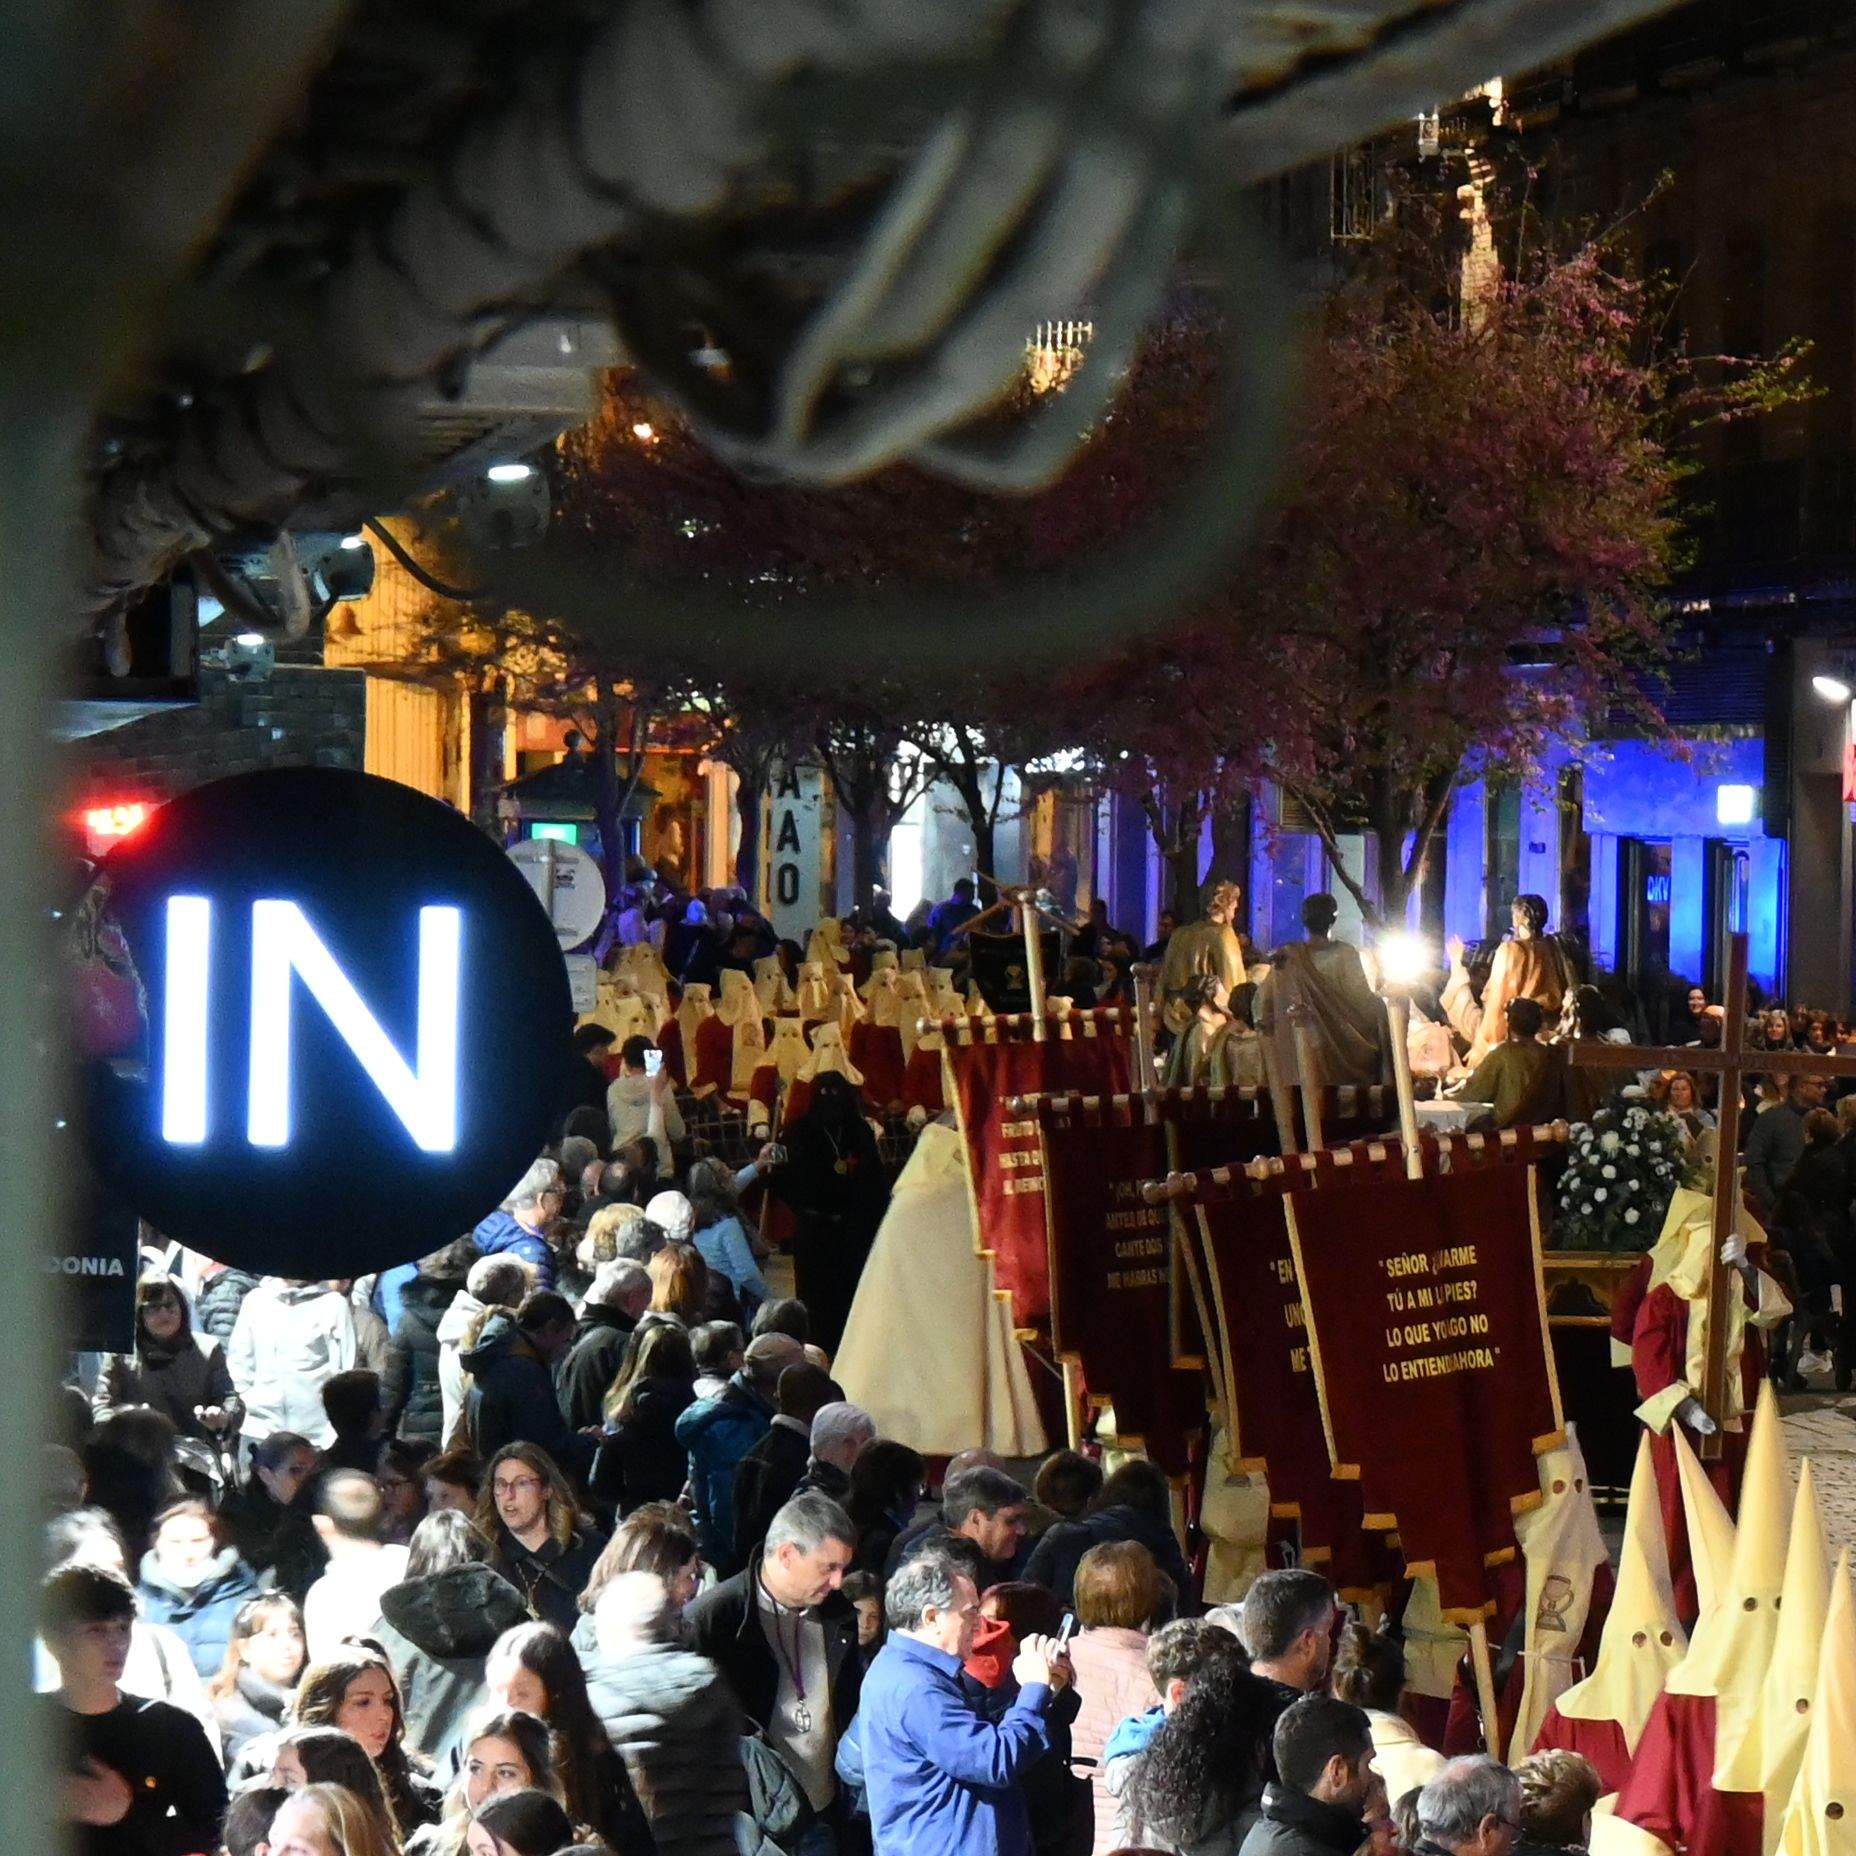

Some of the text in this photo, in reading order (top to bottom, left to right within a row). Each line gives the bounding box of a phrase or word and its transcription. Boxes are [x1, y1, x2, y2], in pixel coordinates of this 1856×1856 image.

[161, 893, 461, 1153] IN
[1407, 1290, 1417, 1310] A
[1417, 1287, 1434, 1308] MI
[1445, 1280, 1478, 1302] PIES?
[1386, 1327, 1402, 1348] LO
[1404, 1323, 1431, 1346] QUE
[1469, 1314, 1489, 1334] NO
[1383, 1363, 1399, 1382] LO
